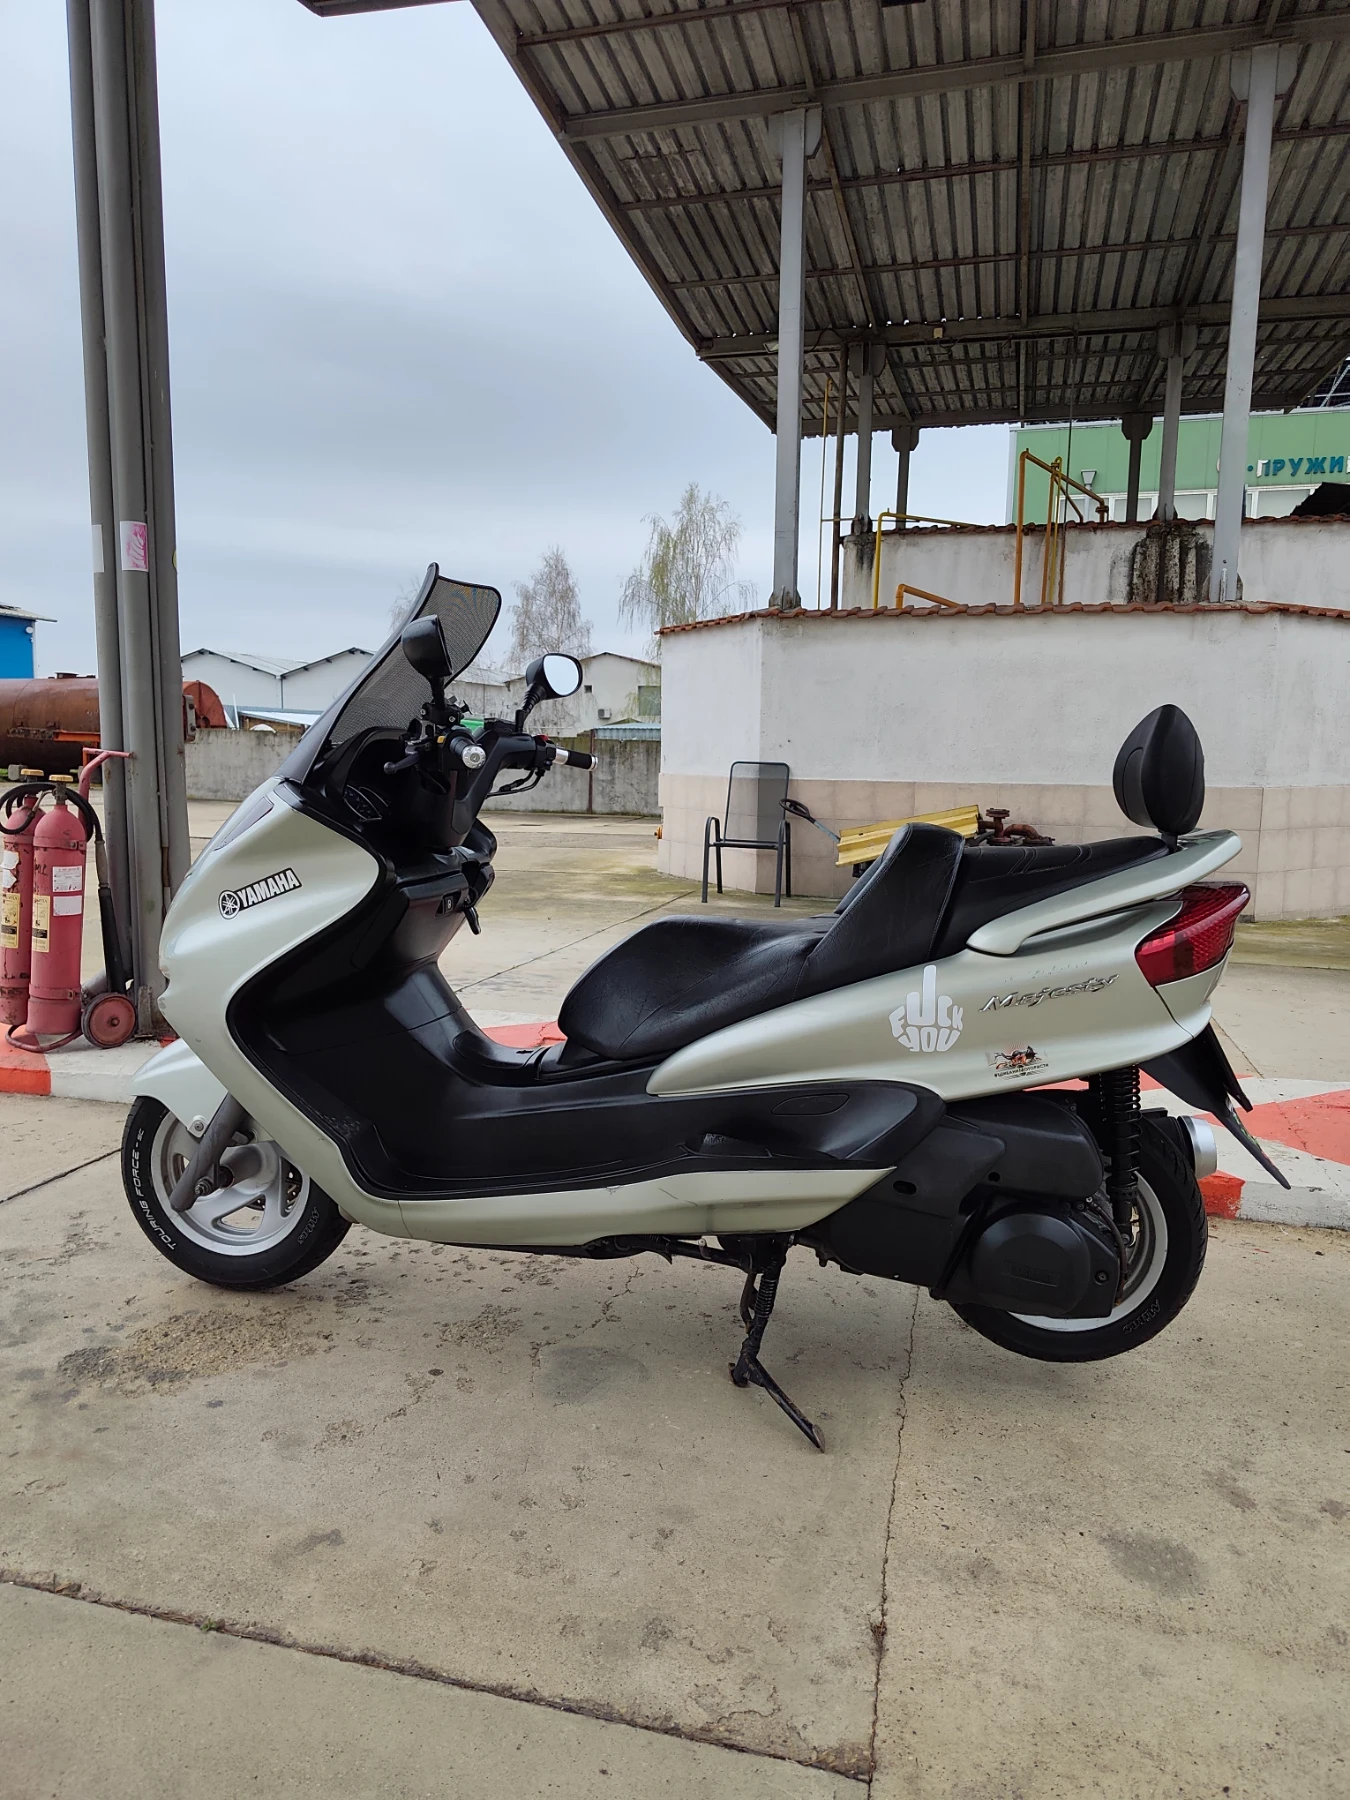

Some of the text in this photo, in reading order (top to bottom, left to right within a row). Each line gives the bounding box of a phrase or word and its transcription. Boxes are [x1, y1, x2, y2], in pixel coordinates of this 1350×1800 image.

[1256, 455, 1350, 478] ПРУЖИ
[237, 870, 301, 908] YAMAHA
[978, 973, 1120, 1013] Majesty
[897, 1026, 961, 1053] YOU
[138, 1200, 177, 1250] TOURING
